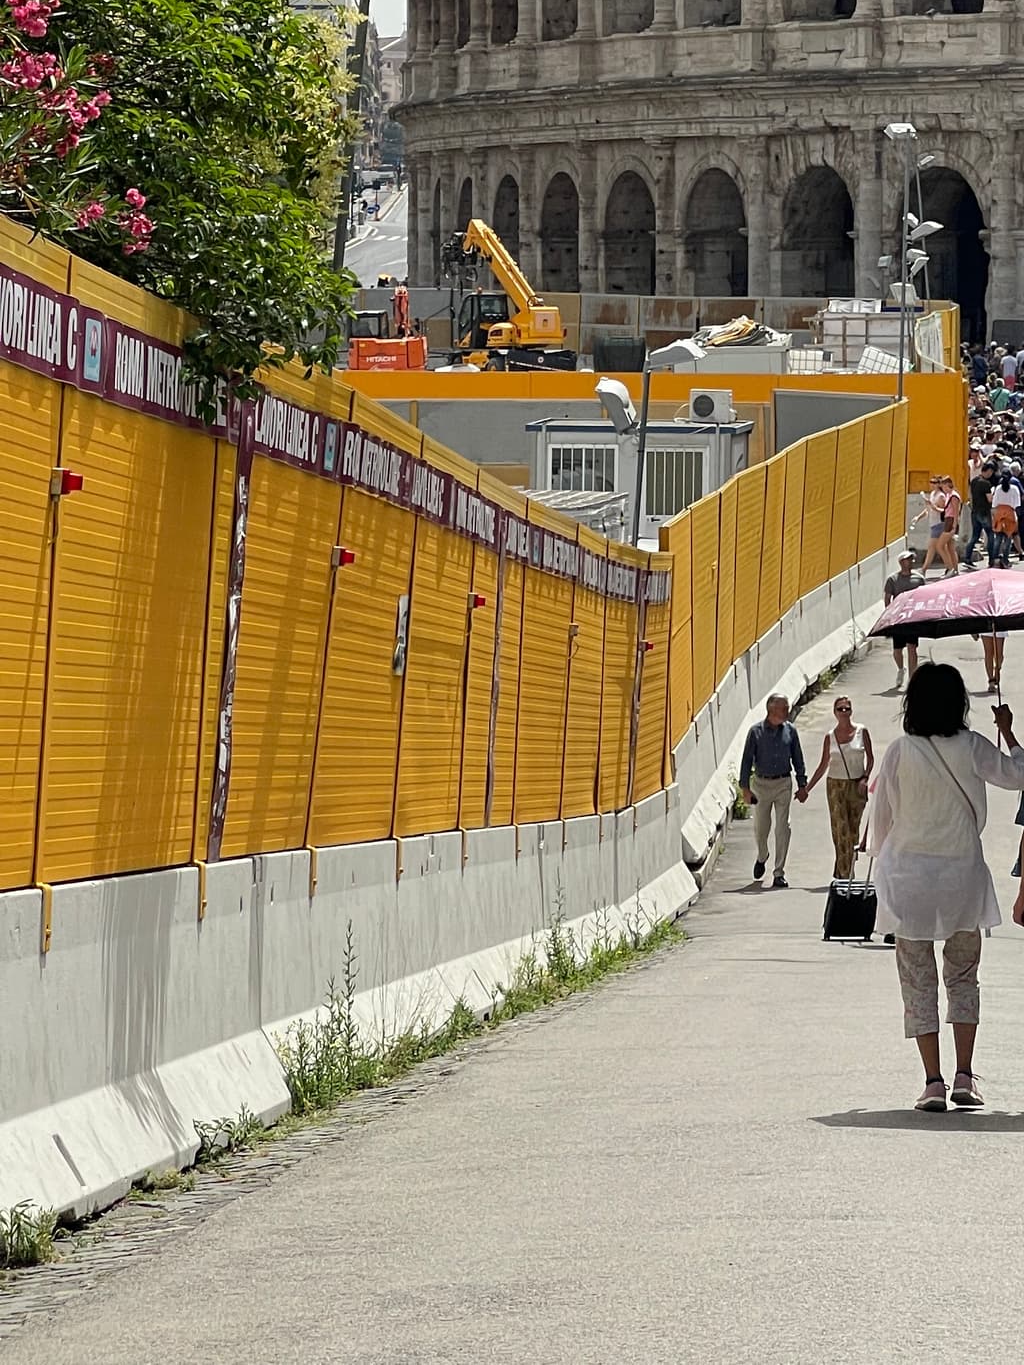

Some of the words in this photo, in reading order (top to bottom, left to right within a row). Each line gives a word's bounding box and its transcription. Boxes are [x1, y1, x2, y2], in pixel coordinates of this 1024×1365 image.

[0, 276, 28, 350] VORI
[27, 290, 62, 365] LINEA
[67, 307, 78, 371] C
[114, 332, 145, 400] ROMA
[366, 355, 397, 363] HITACHI
[254, 394, 287, 451] LAVORI
[311, 416, 319, 464] C
